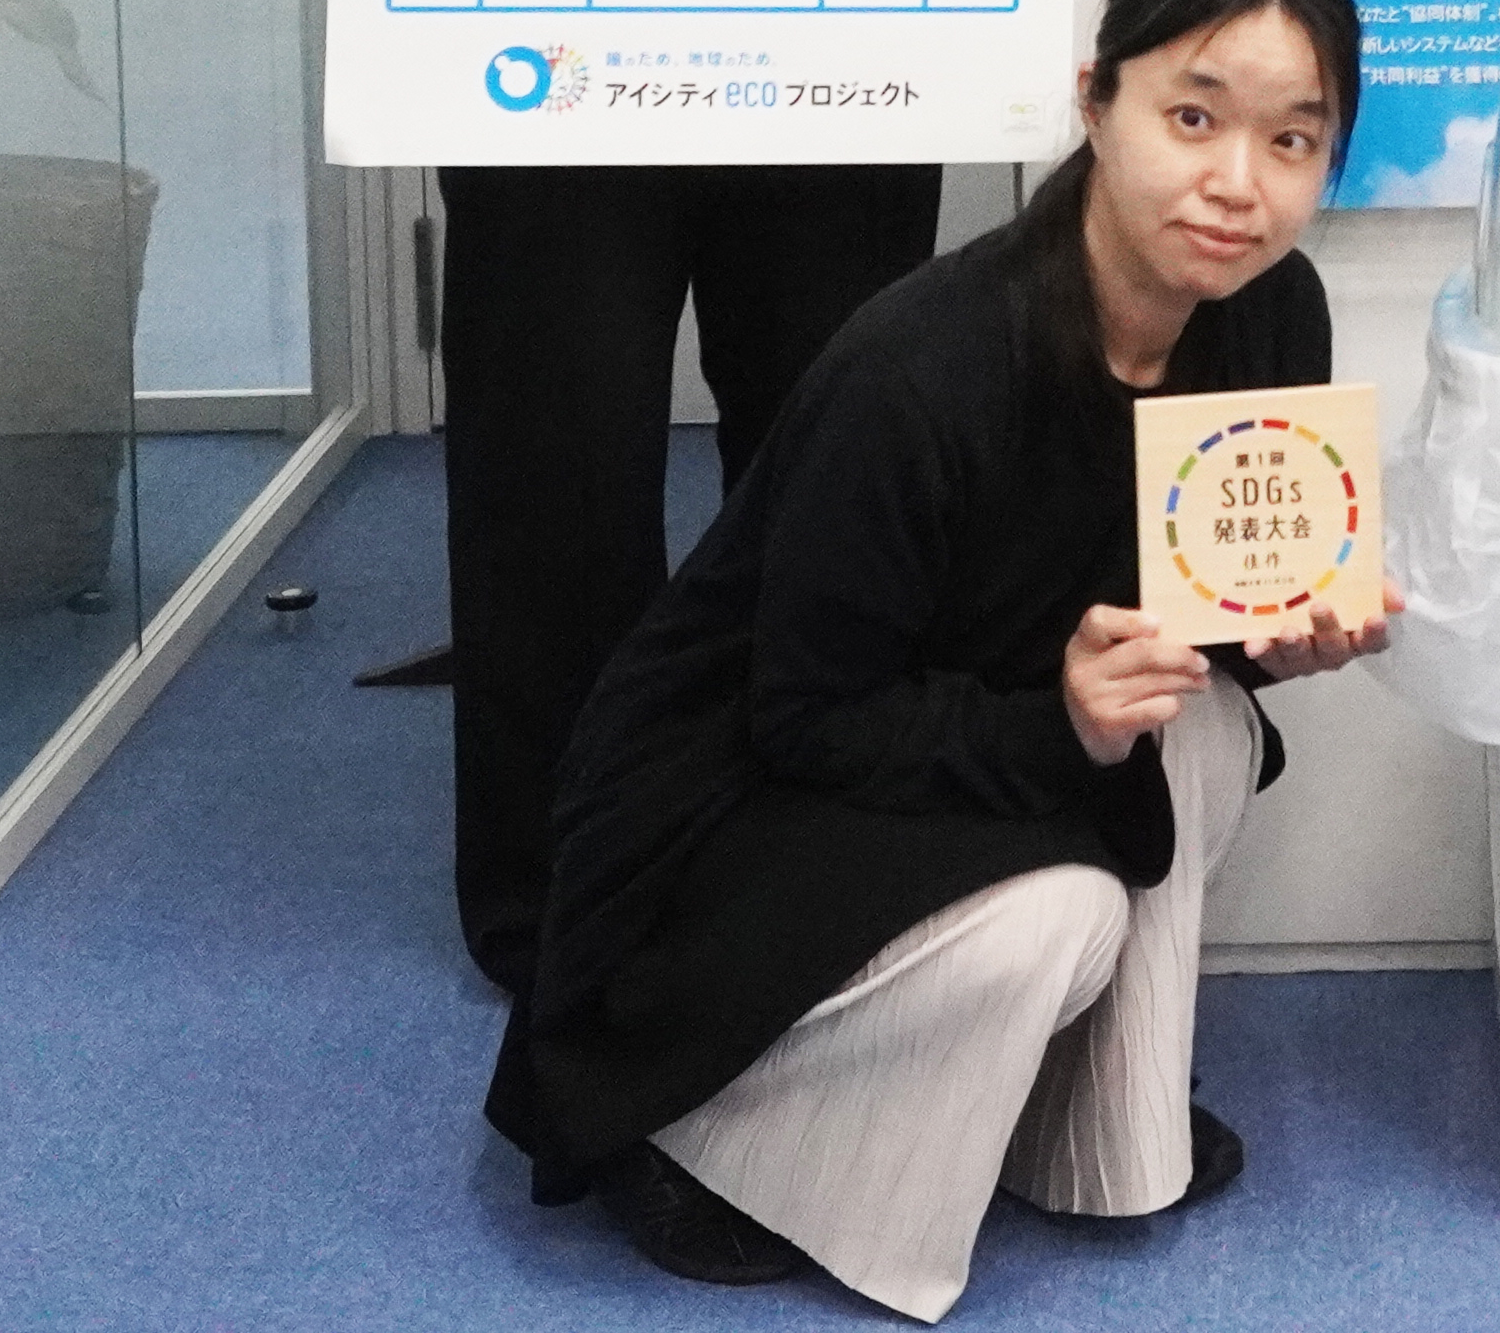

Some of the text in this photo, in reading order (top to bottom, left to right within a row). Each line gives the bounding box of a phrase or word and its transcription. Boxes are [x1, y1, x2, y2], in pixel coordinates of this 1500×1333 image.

[1220, 476, 1303, 508] SDGs
[1213, 514, 1312, 544] 発表大会
